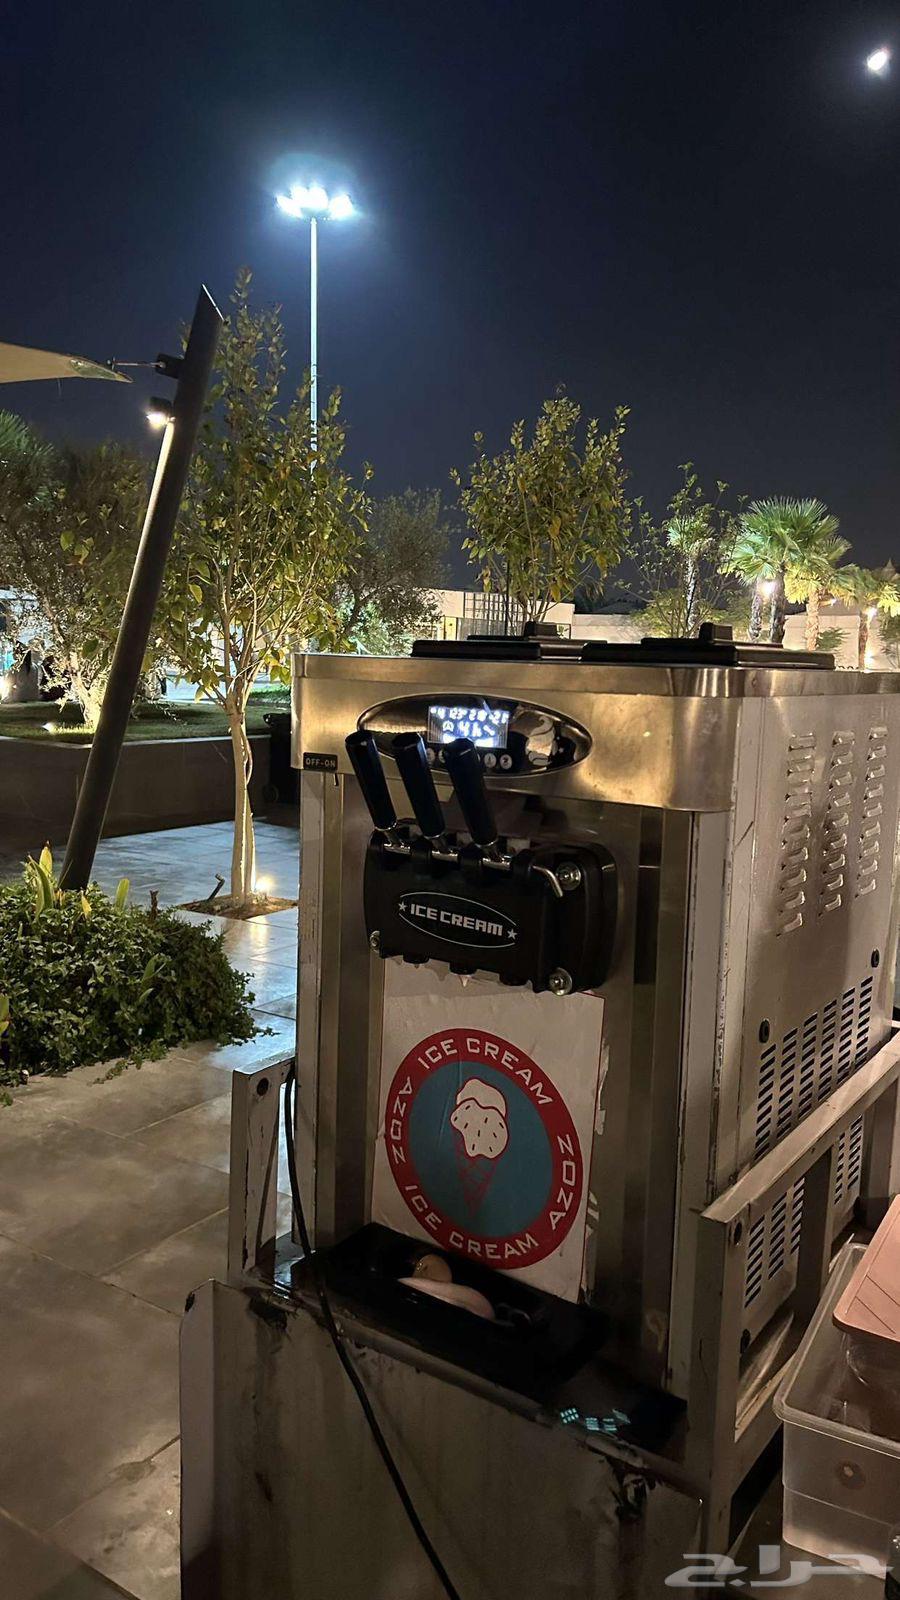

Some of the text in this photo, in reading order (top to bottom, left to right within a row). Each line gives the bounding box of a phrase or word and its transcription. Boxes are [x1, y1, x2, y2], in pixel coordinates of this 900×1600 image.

[305, 757, 336, 768] OFF-ON
[410, 903, 503, 937] ICE CREAM
[417, 1037, 553, 1105] ICE CREAM
[404, 1184, 539, 1260] ICE CREAM
